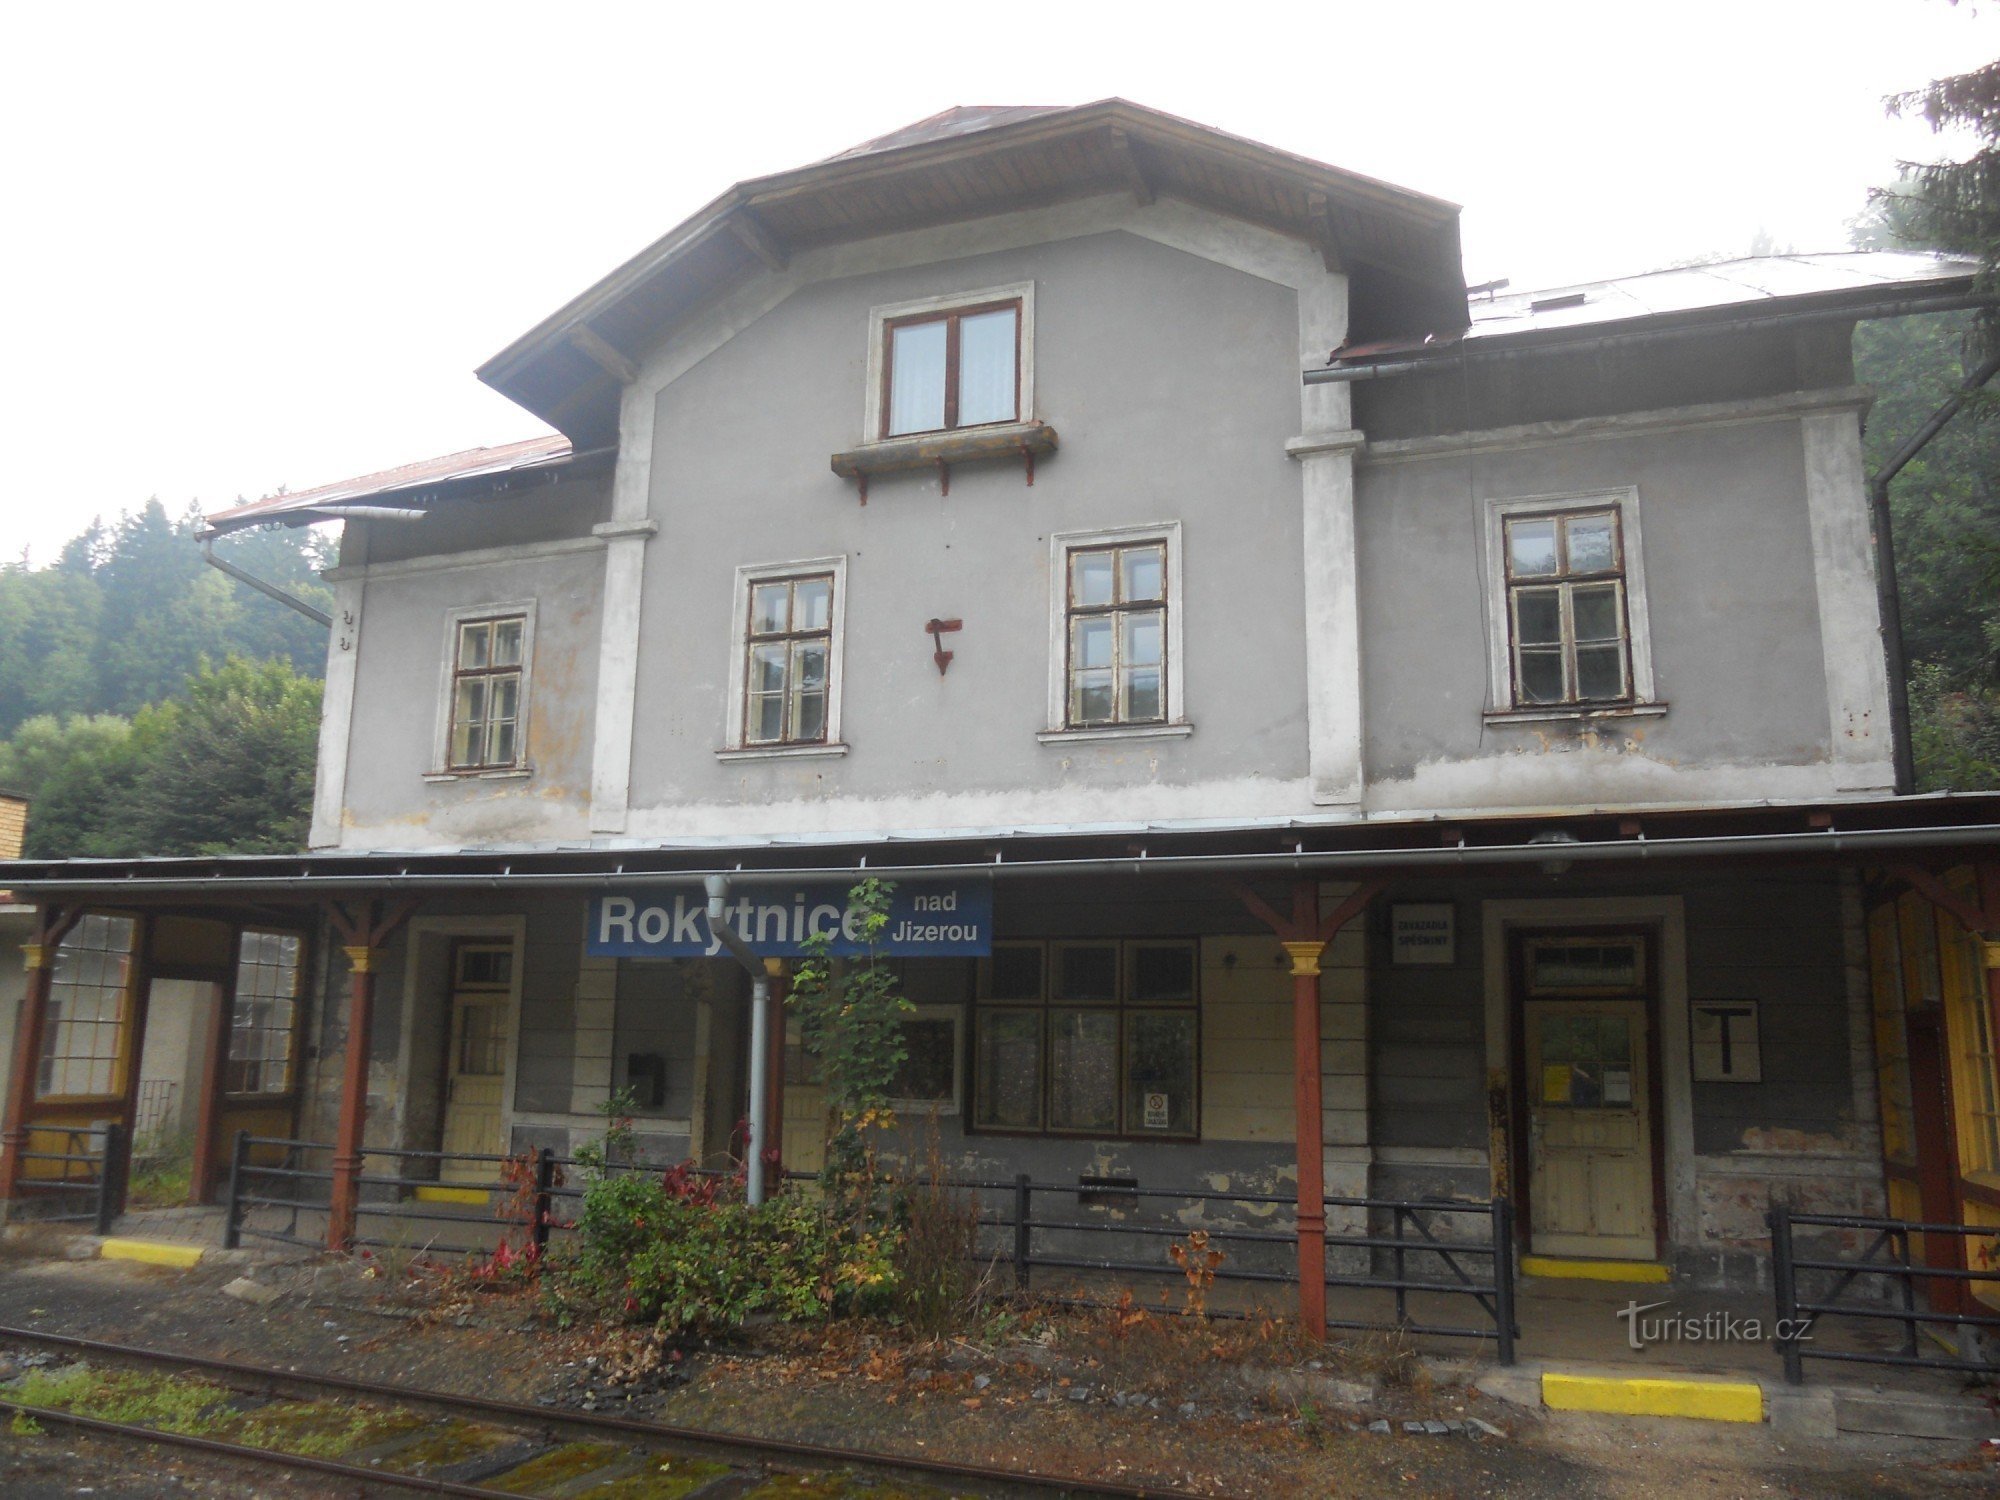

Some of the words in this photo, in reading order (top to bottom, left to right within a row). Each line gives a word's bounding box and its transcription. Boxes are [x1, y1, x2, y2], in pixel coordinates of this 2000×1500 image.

[914, 890, 957, 911] nad
[892, 920, 978, 942] Jizerou
[1696, 1008, 1752, 1074] T
